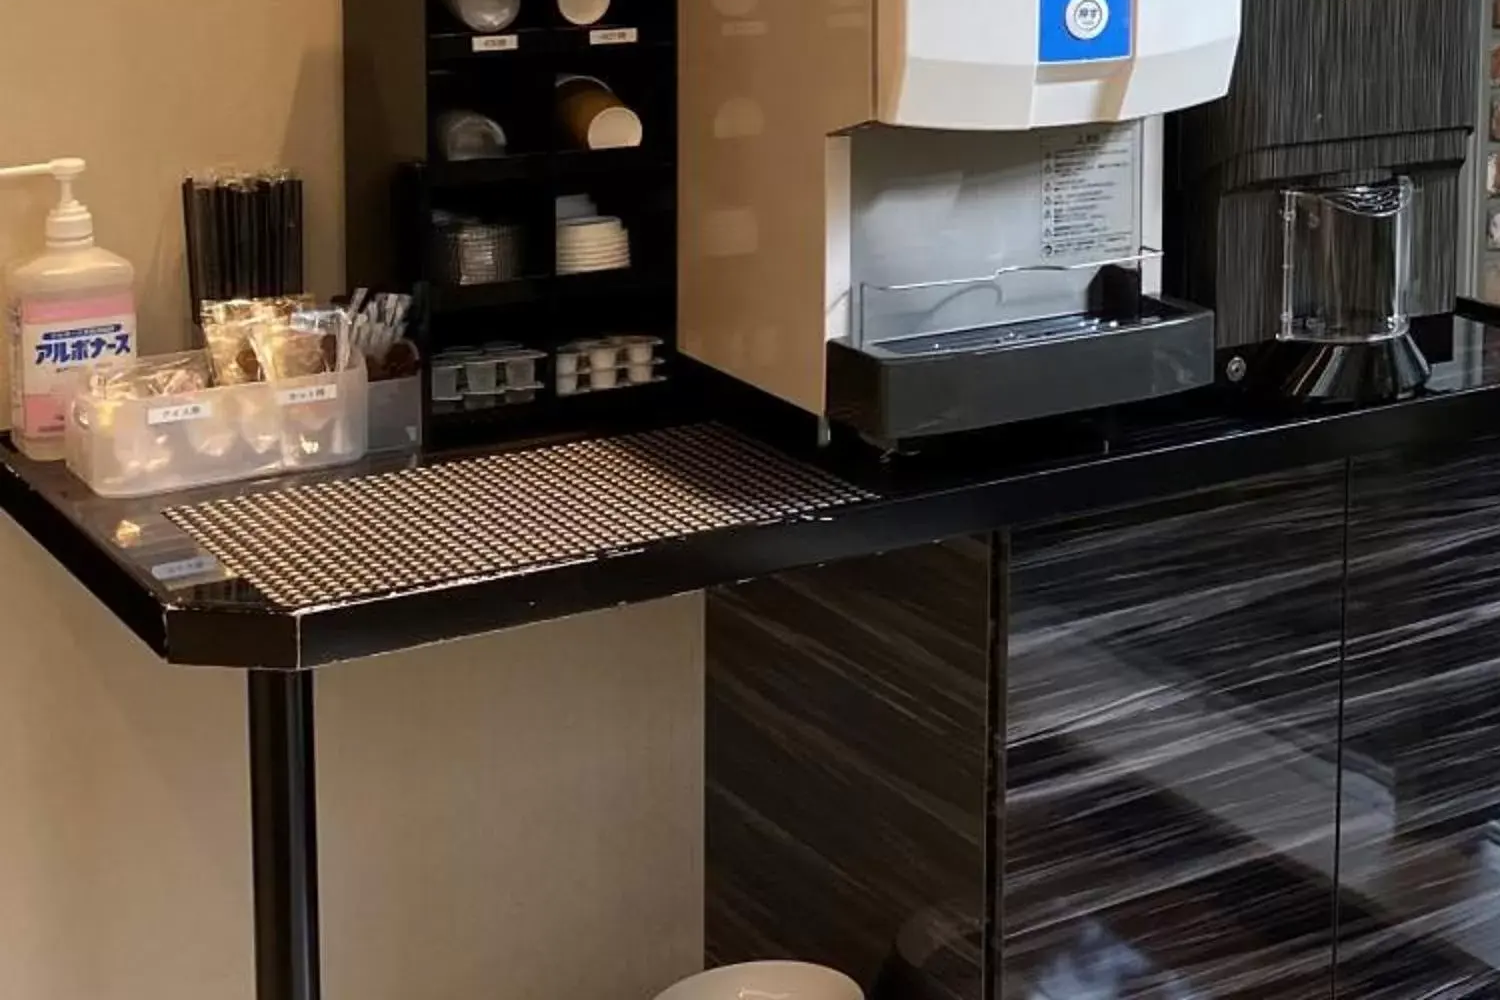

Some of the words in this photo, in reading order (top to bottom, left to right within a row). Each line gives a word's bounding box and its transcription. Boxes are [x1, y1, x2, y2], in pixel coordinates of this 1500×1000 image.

[35, 333, 131, 365] アルボナース
